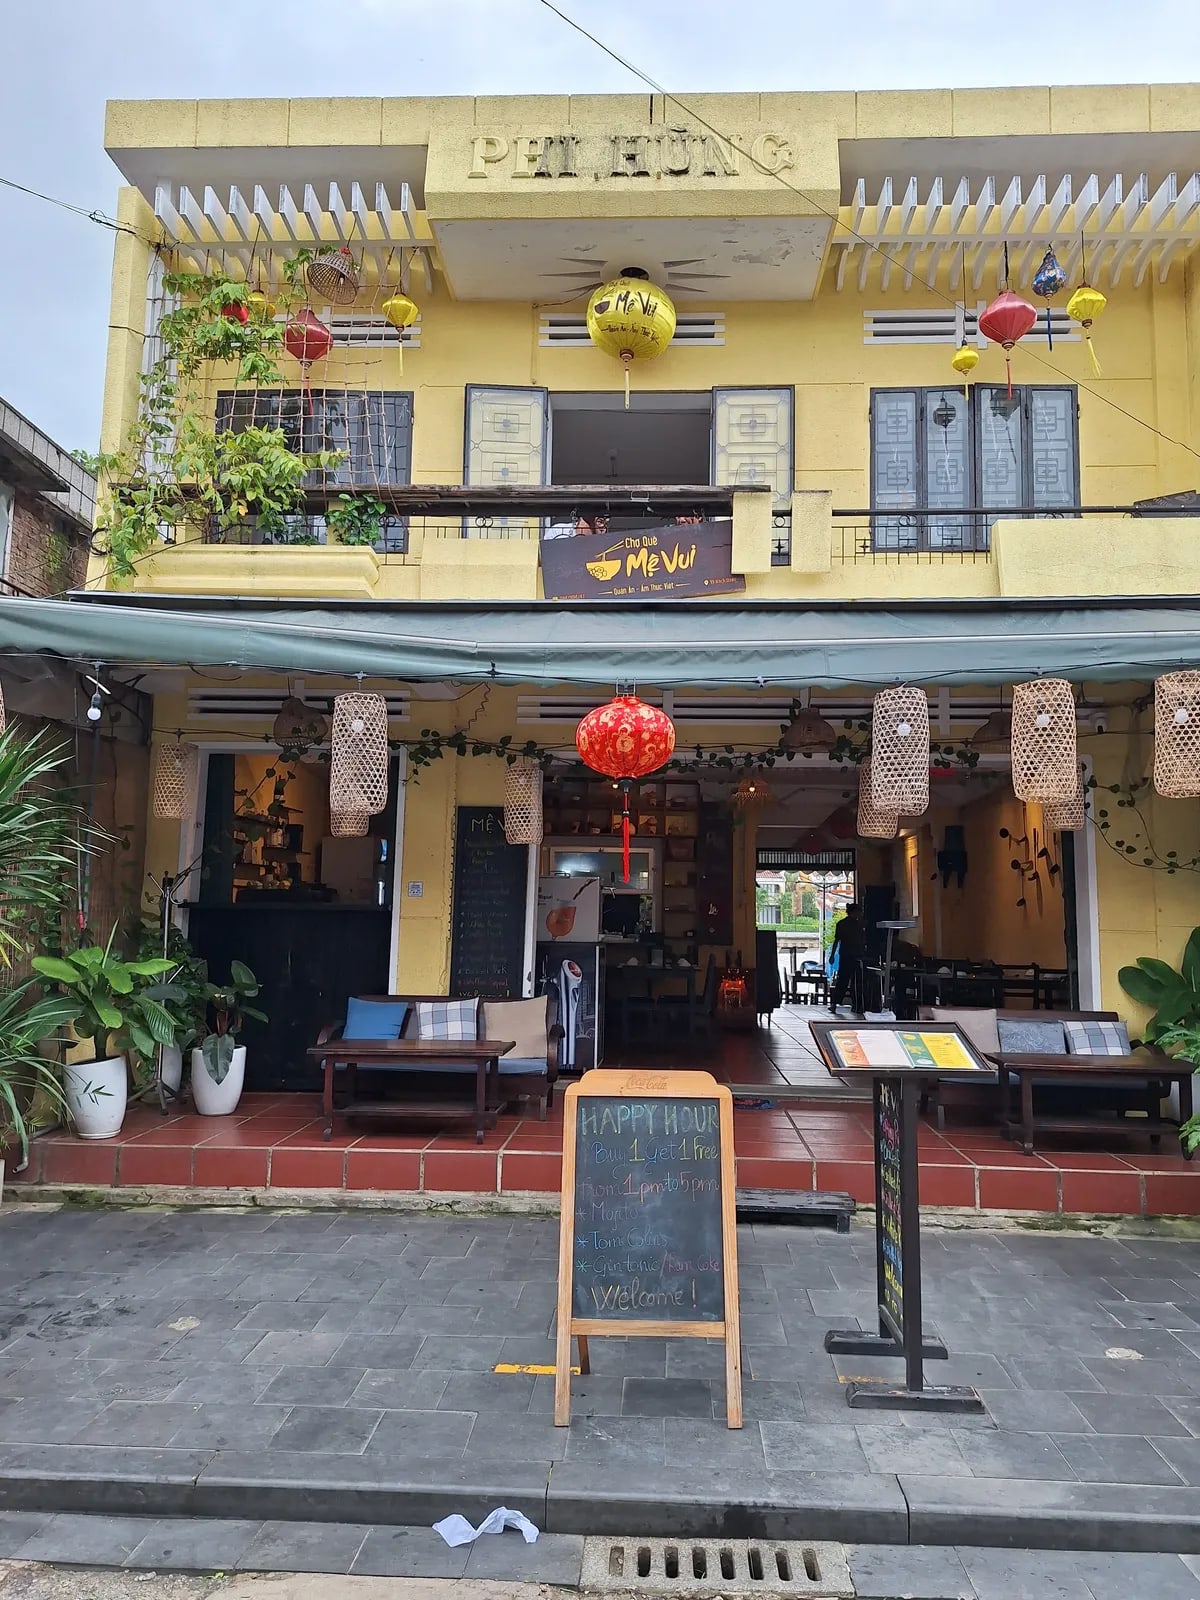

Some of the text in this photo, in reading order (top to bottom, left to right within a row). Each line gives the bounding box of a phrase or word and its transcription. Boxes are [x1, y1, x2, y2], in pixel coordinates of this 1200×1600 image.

[467, 135, 580, 179] PHI
[637, 291, 658, 317] Vui
[660, 543, 697, 573] Vui
[581, 1105, 719, 1135] HAPPY HOUR
[629, 1138, 645, 1162] 1
[679, 1138, 694, 1160] 1
[694, 1136, 719, 1160] Free
[589, 1230, 624, 1250] Tom
